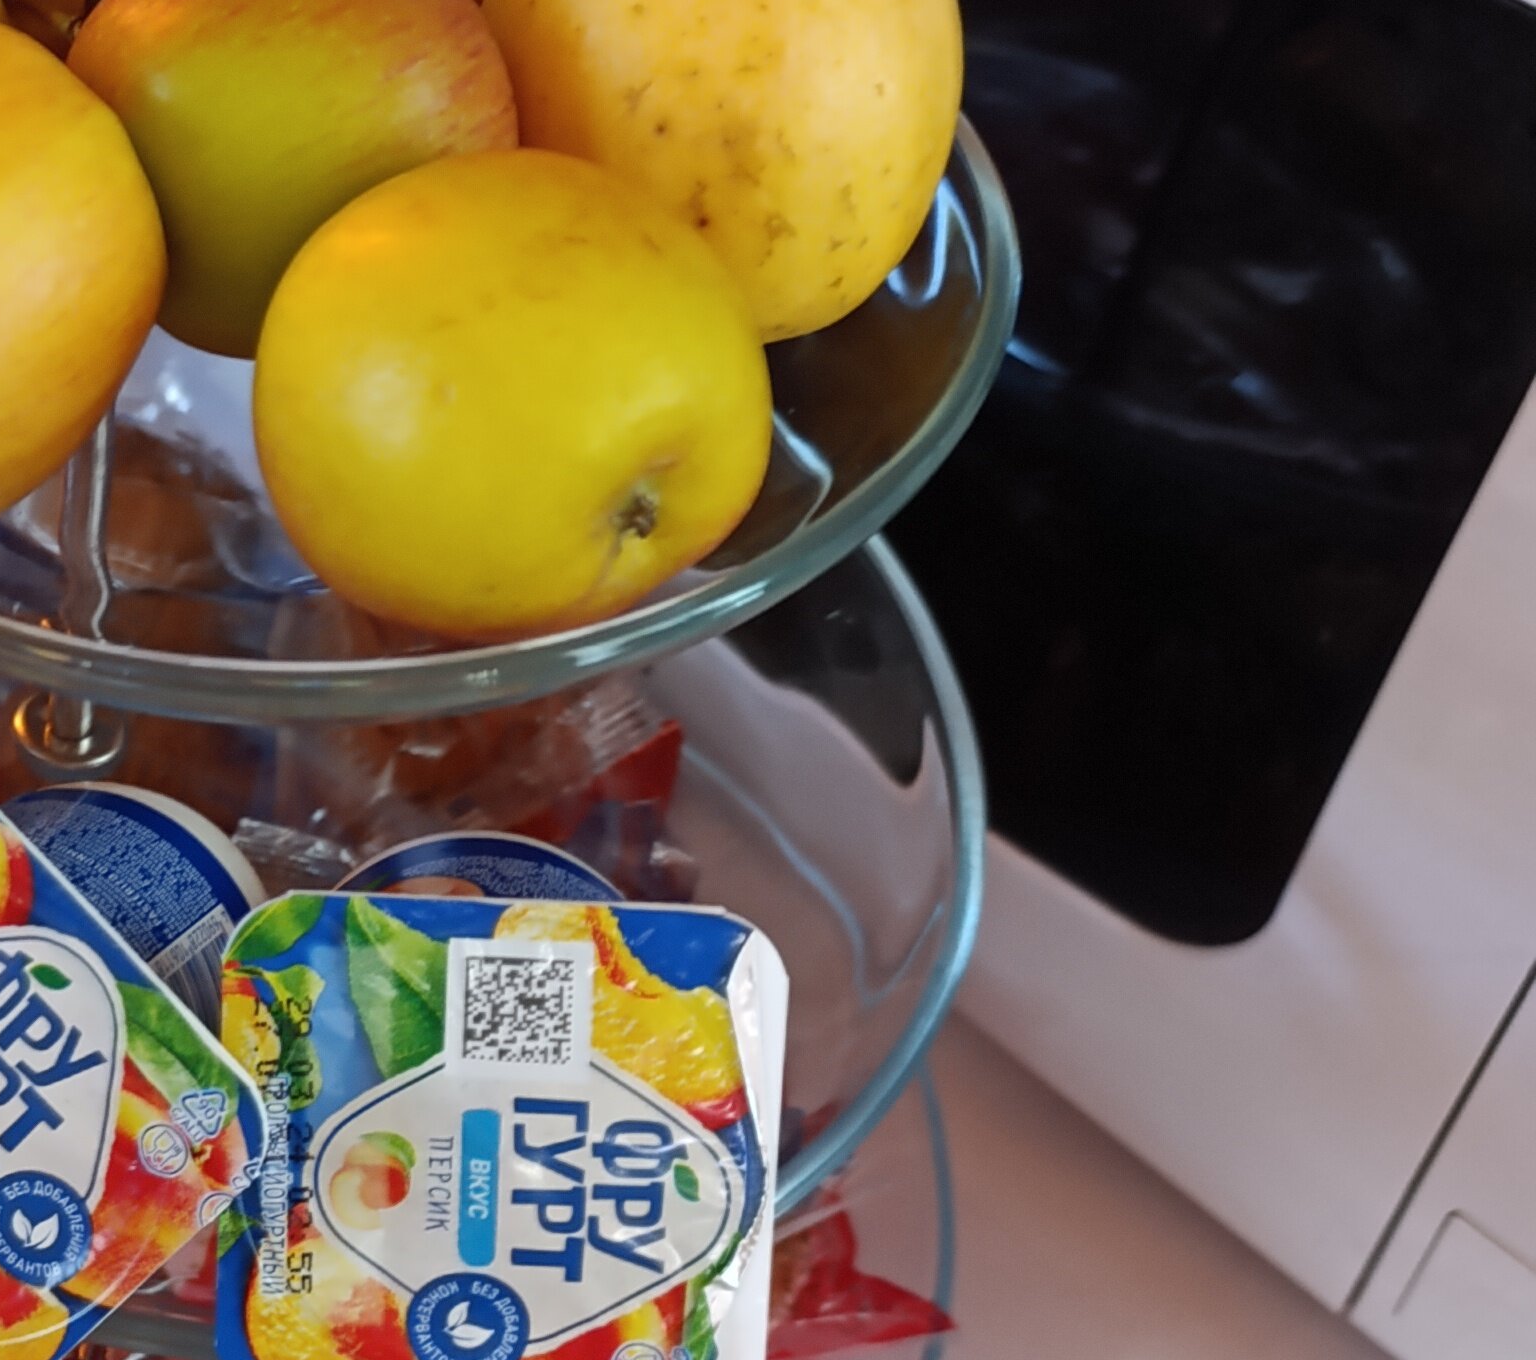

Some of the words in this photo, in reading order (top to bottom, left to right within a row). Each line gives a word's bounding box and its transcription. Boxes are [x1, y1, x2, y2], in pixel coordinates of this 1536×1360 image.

[2, 1179, 31, 1201] БЕЗ
[32, 1179, 86, 1264] ДОБАВЛЕНИЯ
[423, 1135, 455, 1232] ПЕРСИК
[468, 1158, 492, 1221] ВКУС
[510, 1096, 590, 1283] ГУРТ
[588, 1119, 690, 1275] ФРУ
[261, 1173, 292, 1297] ЙОГУРТНЫЙ
[470, 1279, 497, 1300] БЕЗ
